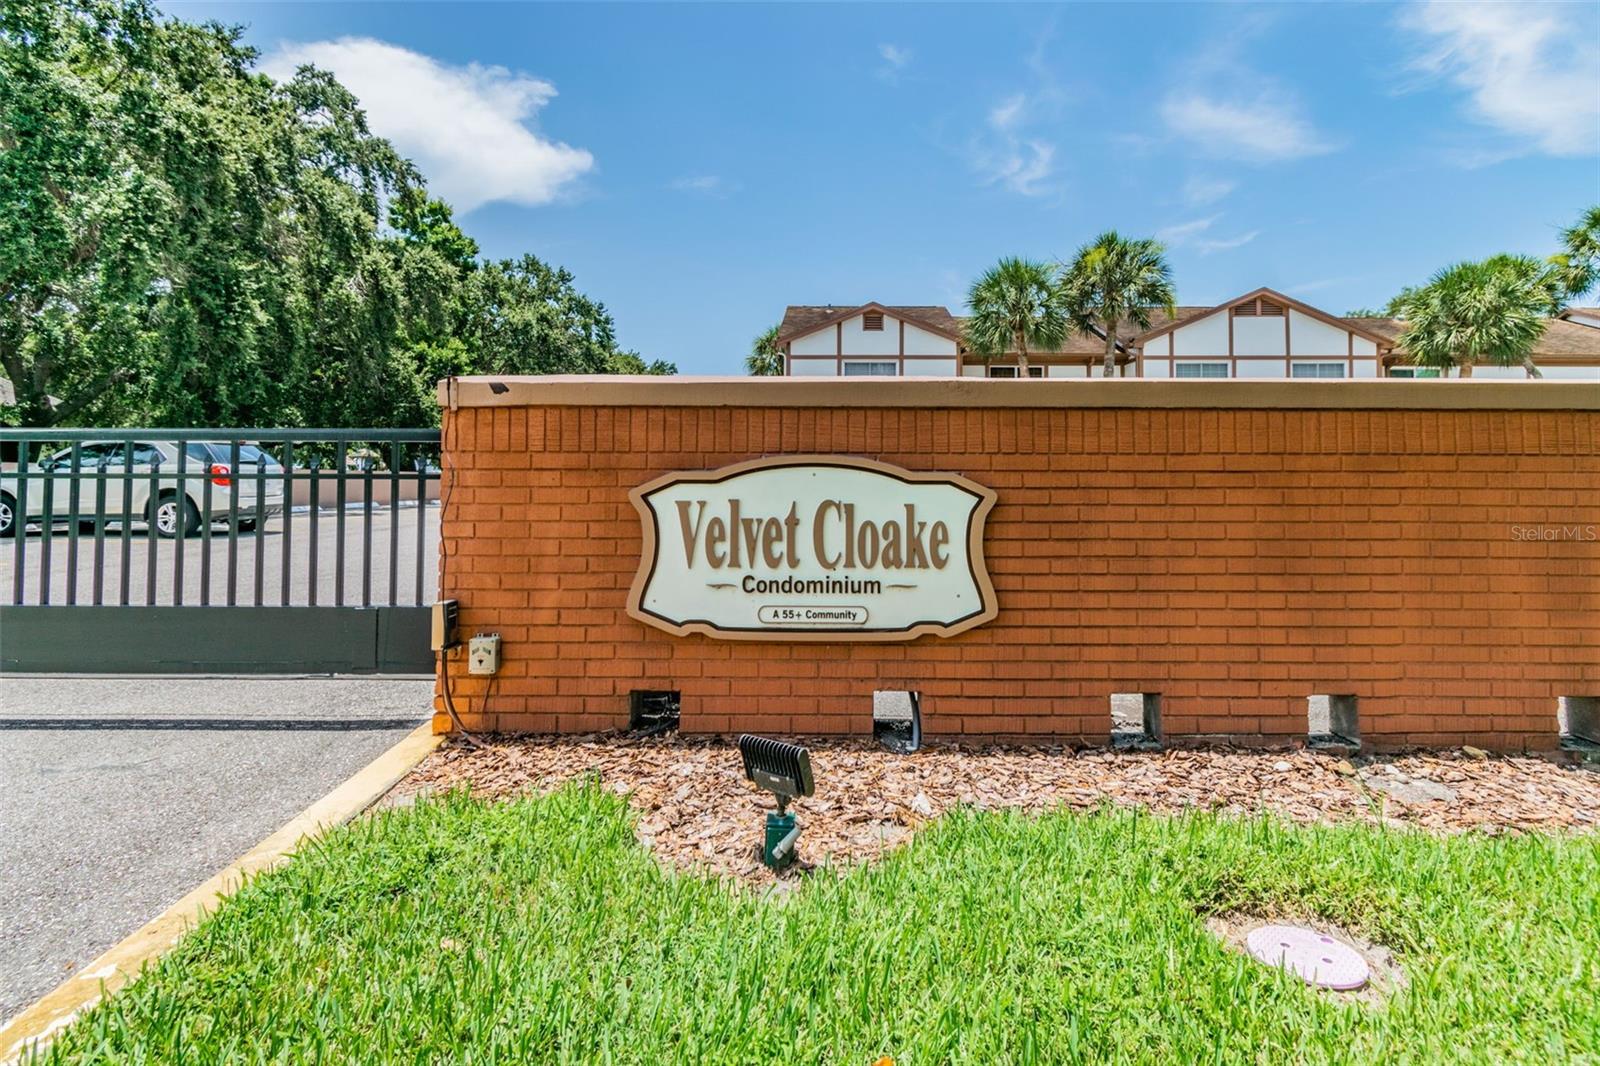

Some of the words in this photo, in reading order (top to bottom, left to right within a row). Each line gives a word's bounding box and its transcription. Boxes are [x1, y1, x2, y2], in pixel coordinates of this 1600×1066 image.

[675, 499, 801, 569] Velvet
[813, 499, 950, 570] Cloake
[742, 575, 882, 594] Condominium
[772, 610, 780, 619] A
[782, 610, 803, 619] 55+
[805, 609, 857, 621] Community
